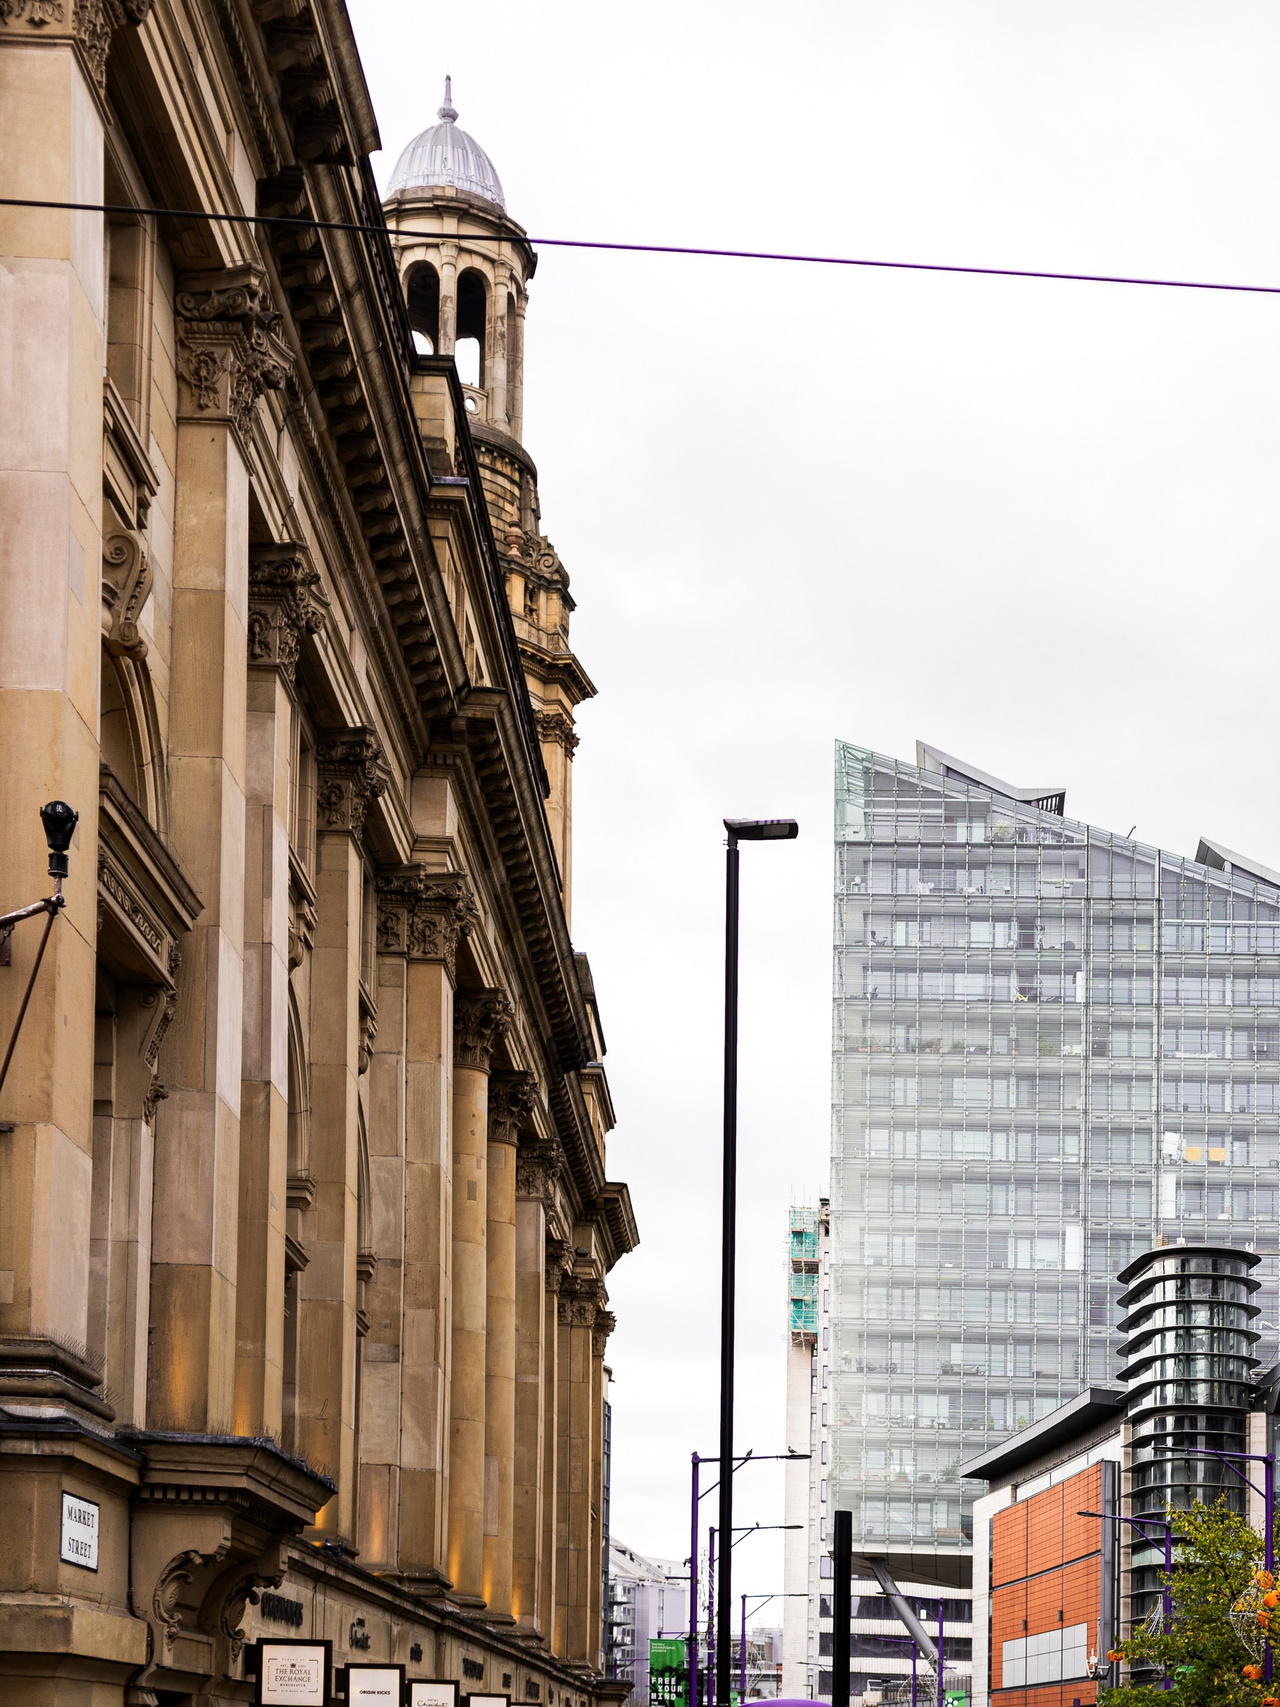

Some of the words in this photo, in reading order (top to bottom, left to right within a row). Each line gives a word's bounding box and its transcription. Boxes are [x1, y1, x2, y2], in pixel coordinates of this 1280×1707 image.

[67, 1505, 95, 1528] MARKET
[68, 1537, 92, 1559] STREET
[289, 1668, 311, 1676] ROYAL
[275, 1675, 311, 1683] EXCHANGE
[651, 1676, 676, 1685] FREE
[657, 1684, 683, 1693] YOUR
[650, 1692, 677, 1701] MIND
